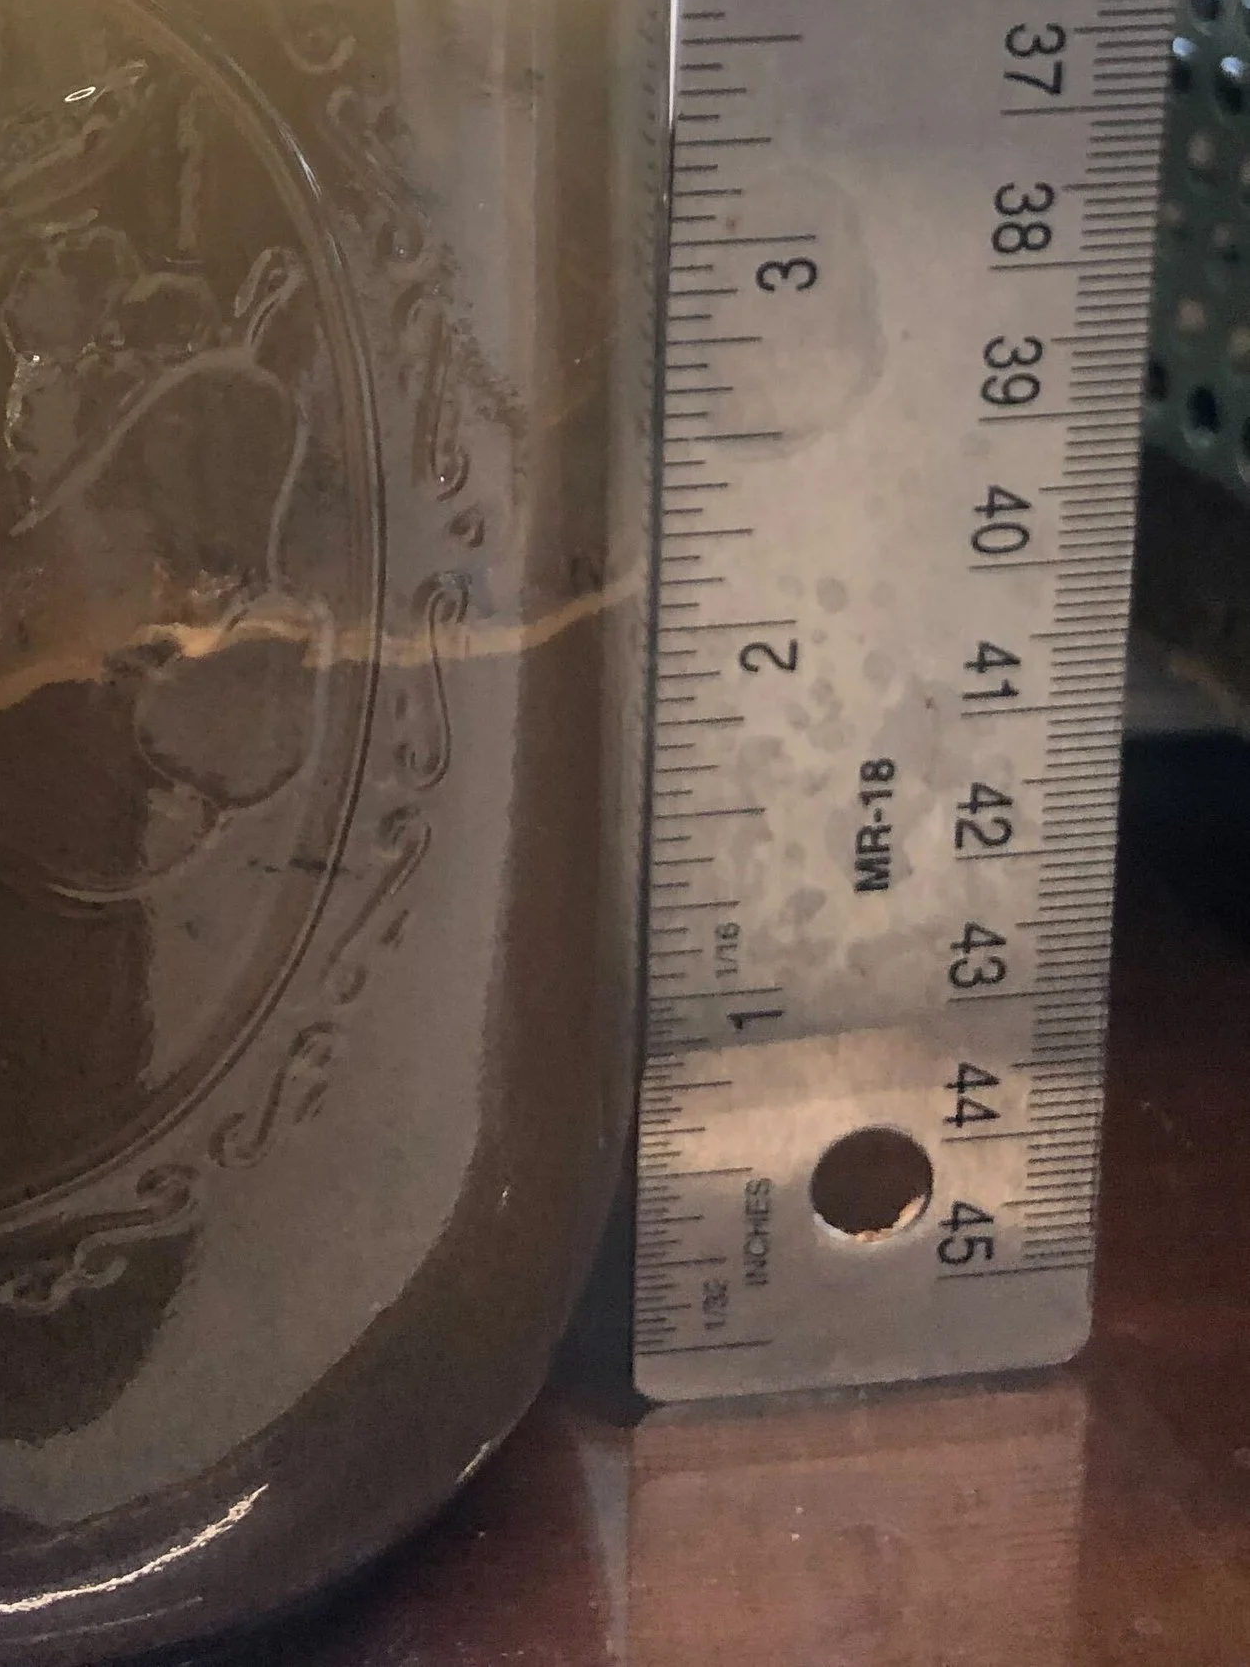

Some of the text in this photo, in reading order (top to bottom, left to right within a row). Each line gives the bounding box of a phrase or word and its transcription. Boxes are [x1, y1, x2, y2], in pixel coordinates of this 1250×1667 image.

[1003, 23, 1067, 96] 37
[991, 182, 1056, 255] 38
[755, 257, 818, 292] 3
[980, 336, 1044, 407] 39
[970, 485, 1032, 556] 40
[739, 639, 799, 673] 2
[962, 642, 1021, 701] 41
[853, 758, 896, 893] MR-18
[954, 781, 1014, 851] 42
[948, 922, 1008, 990] 43
[726, 1009, 786, 1032] 1
[944, 1062, 1001, 1129] 44
[742, 1177, 771, 1287] INCHES
[936, 1201, 995, 1267] 45
